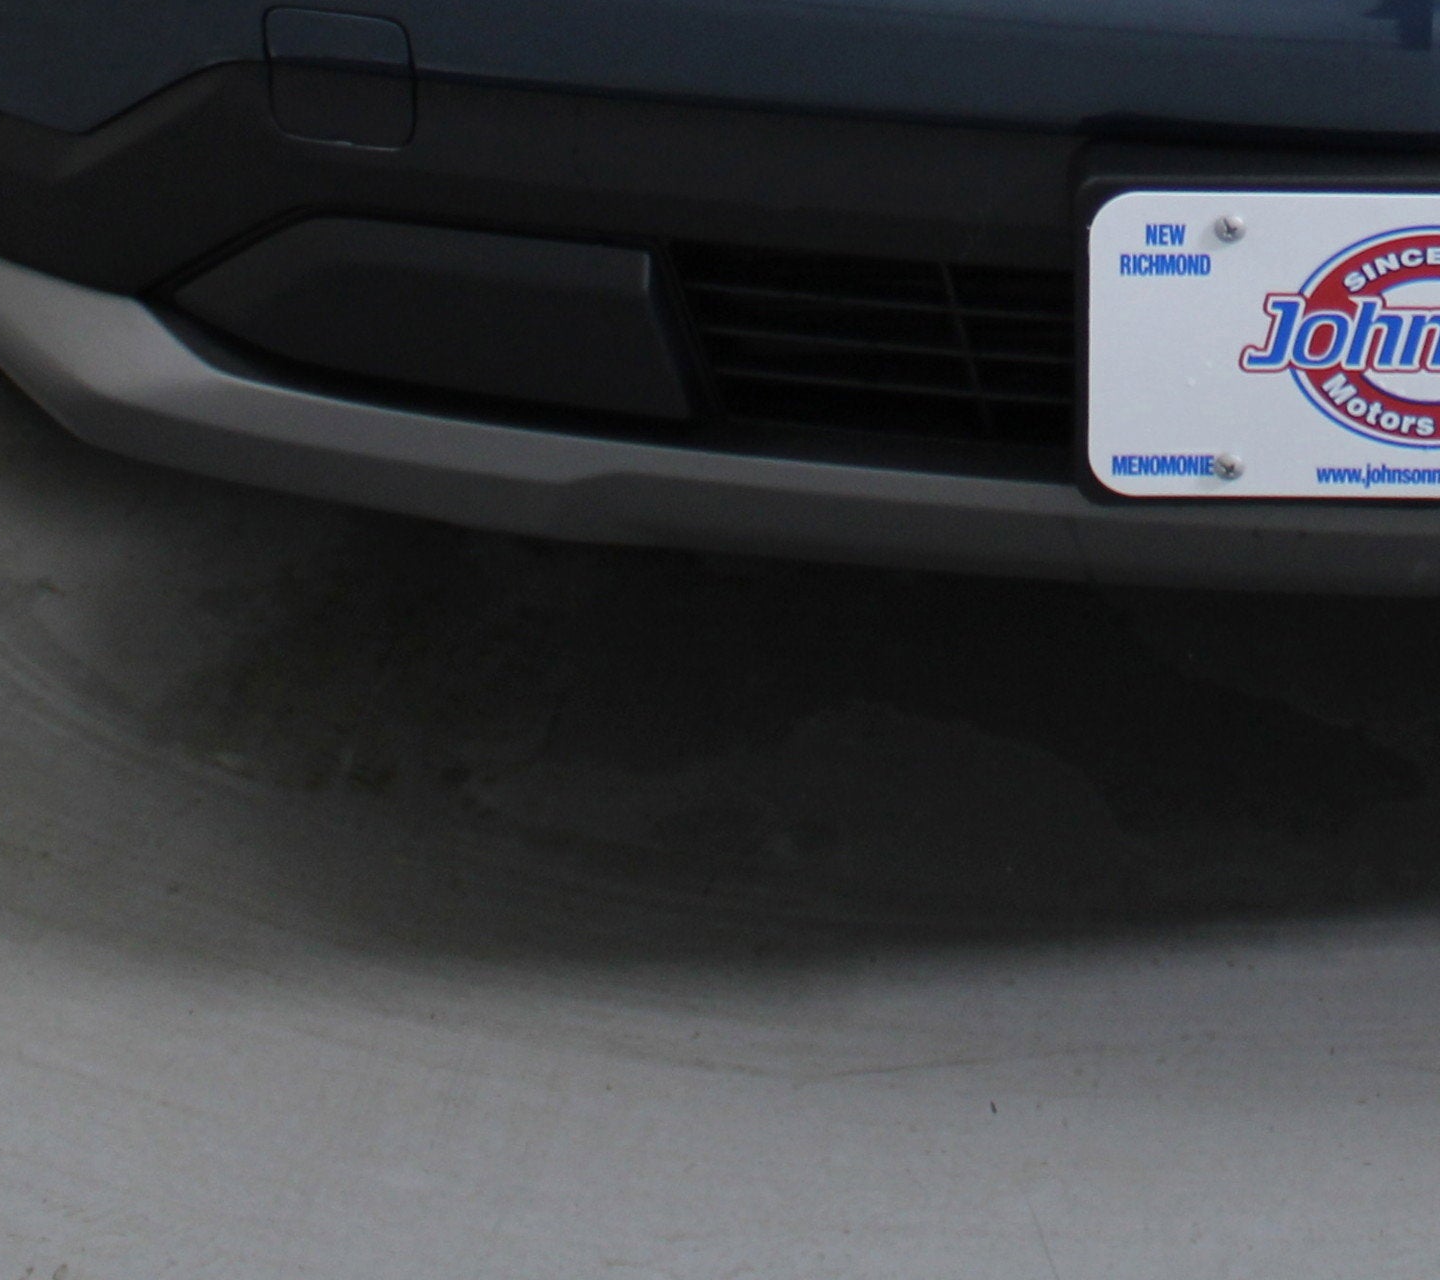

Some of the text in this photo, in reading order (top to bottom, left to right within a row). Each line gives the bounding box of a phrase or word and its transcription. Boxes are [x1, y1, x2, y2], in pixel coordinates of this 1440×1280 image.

[1145, 224, 1186, 246] NEW
[1120, 254, 1212, 276] RICHMOND
[1321, 372, 1435, 437] Motors
[1111, 454, 1216, 476] MENOMONIE
